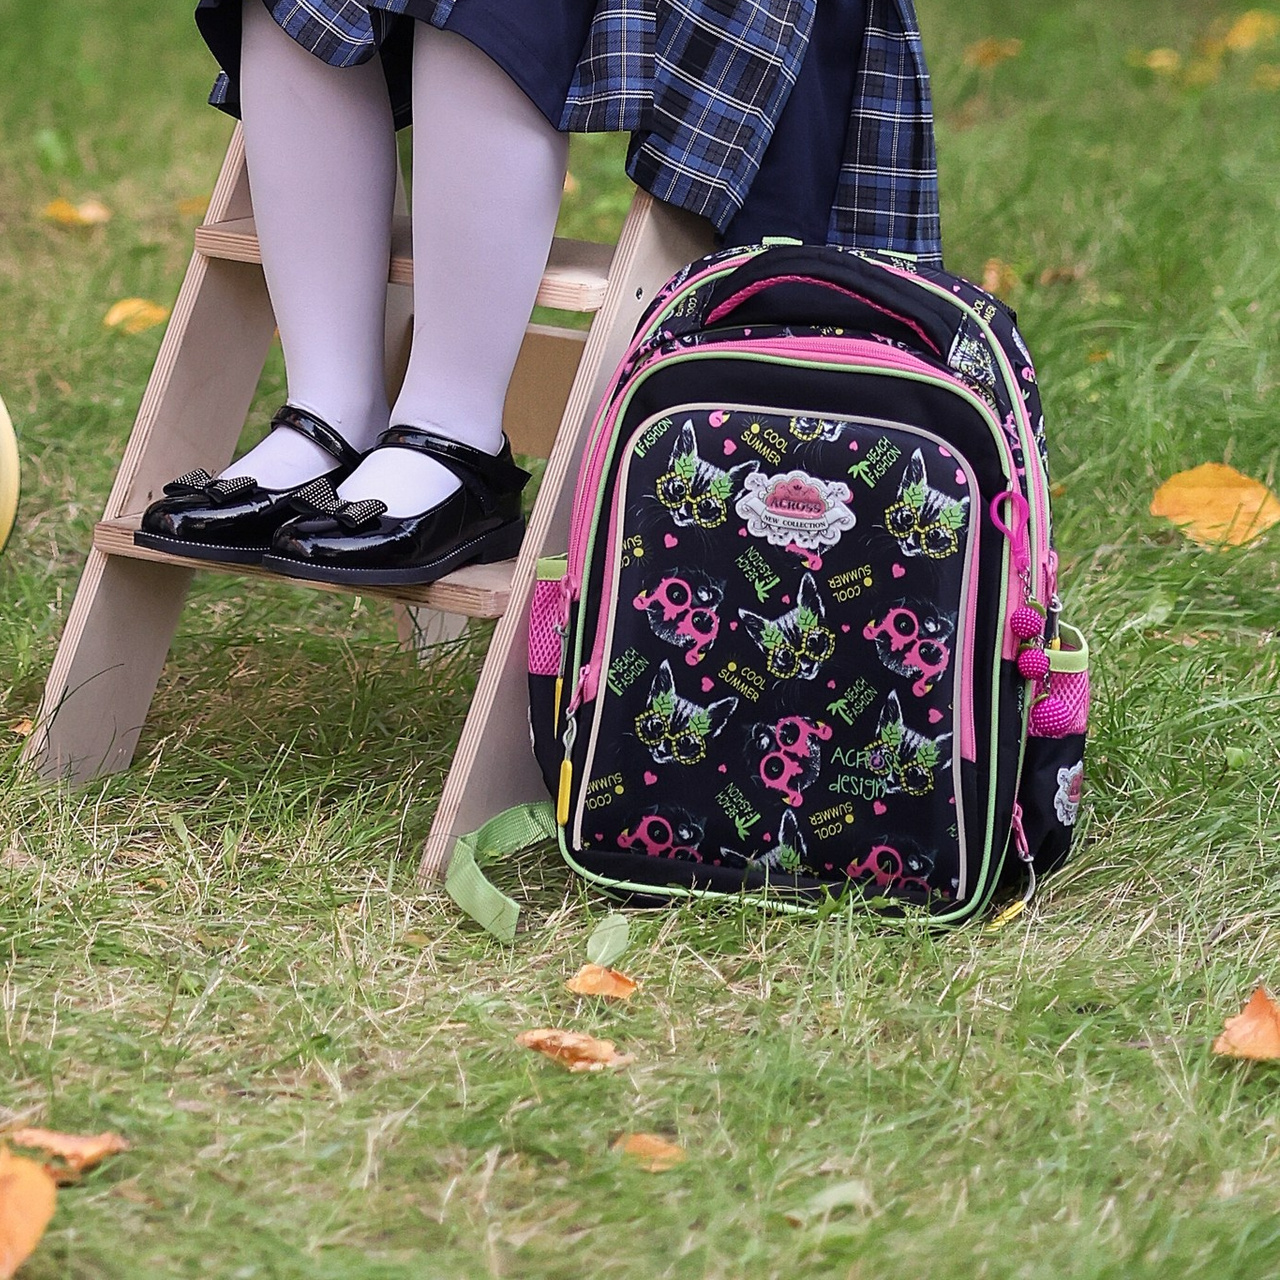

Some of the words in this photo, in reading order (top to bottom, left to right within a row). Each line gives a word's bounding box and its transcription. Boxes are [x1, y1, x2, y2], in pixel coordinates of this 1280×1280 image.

[639, 417, 673, 454] FASHION
[741, 430, 781, 467] SUMMER
[763, 429, 790, 454] COOL
[866, 436, 891, 464] BEACH
[868, 446, 902, 484] FASHION
[770, 498, 822, 513] ACROSS
[764, 516, 779, 525] NEW
[782, 519, 826, 529] COLLECTION
[734, 555, 758, 582] BEACH
[745, 545, 778, 584] FASHION
[828, 564, 872, 589] SUMMER
[833, 586, 861, 603] COOL
[613, 647, 639, 673] BEACH
[617, 656, 649, 692] FASHION
[718, 668, 760, 703] SUMMER
[741, 667, 766, 691] COOL
[844, 676, 869, 702] BEACH
[847, 686, 878, 721] FASHION
[725, 782, 759, 820] FASHION
[828, 774, 887, 801] design
[714, 791, 739, 819] BEACH
[808, 801, 853, 826] SUMMER
[814, 822, 843, 840] COOL
